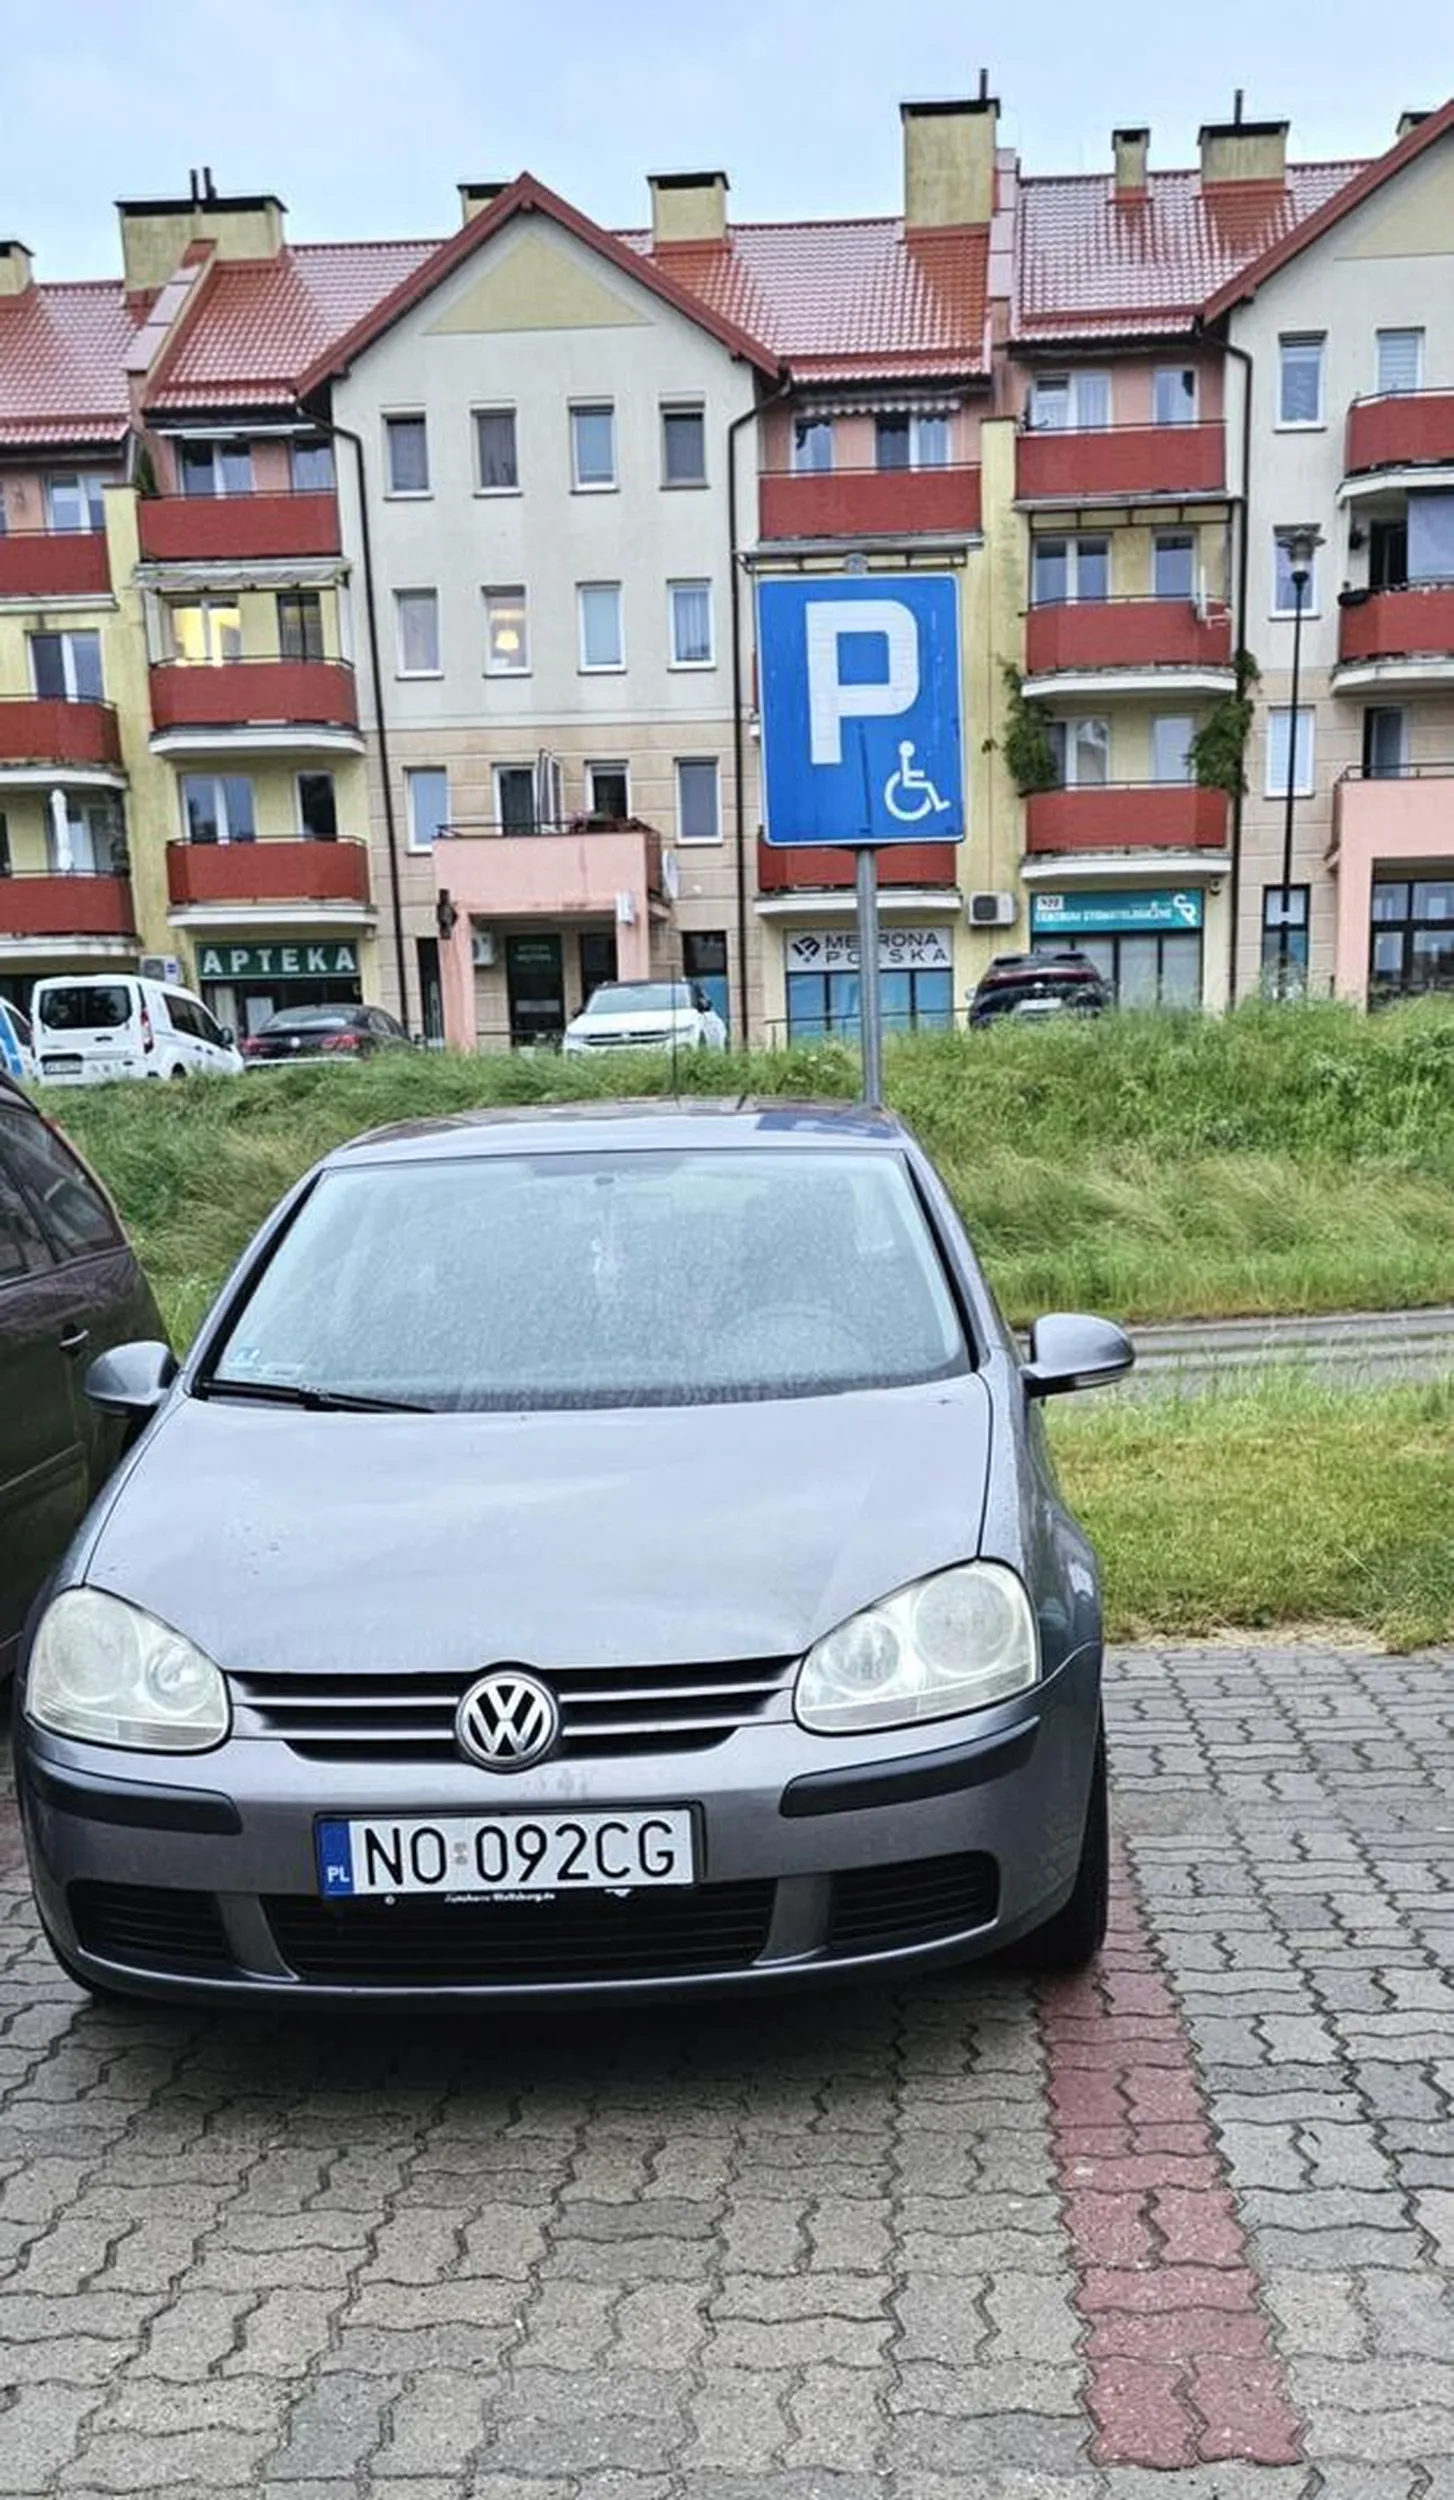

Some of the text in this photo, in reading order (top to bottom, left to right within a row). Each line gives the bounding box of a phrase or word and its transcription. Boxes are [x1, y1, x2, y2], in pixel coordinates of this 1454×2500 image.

[805, 599, 919, 765] P
[825, 931, 939, 949] MERONA
[203, 946, 355, 973] APTEKA
[826, 948, 947, 964] POSKA
[364, 1820, 675, 1886] NO 092CG
[327, 1866, 350, 1883] PL
